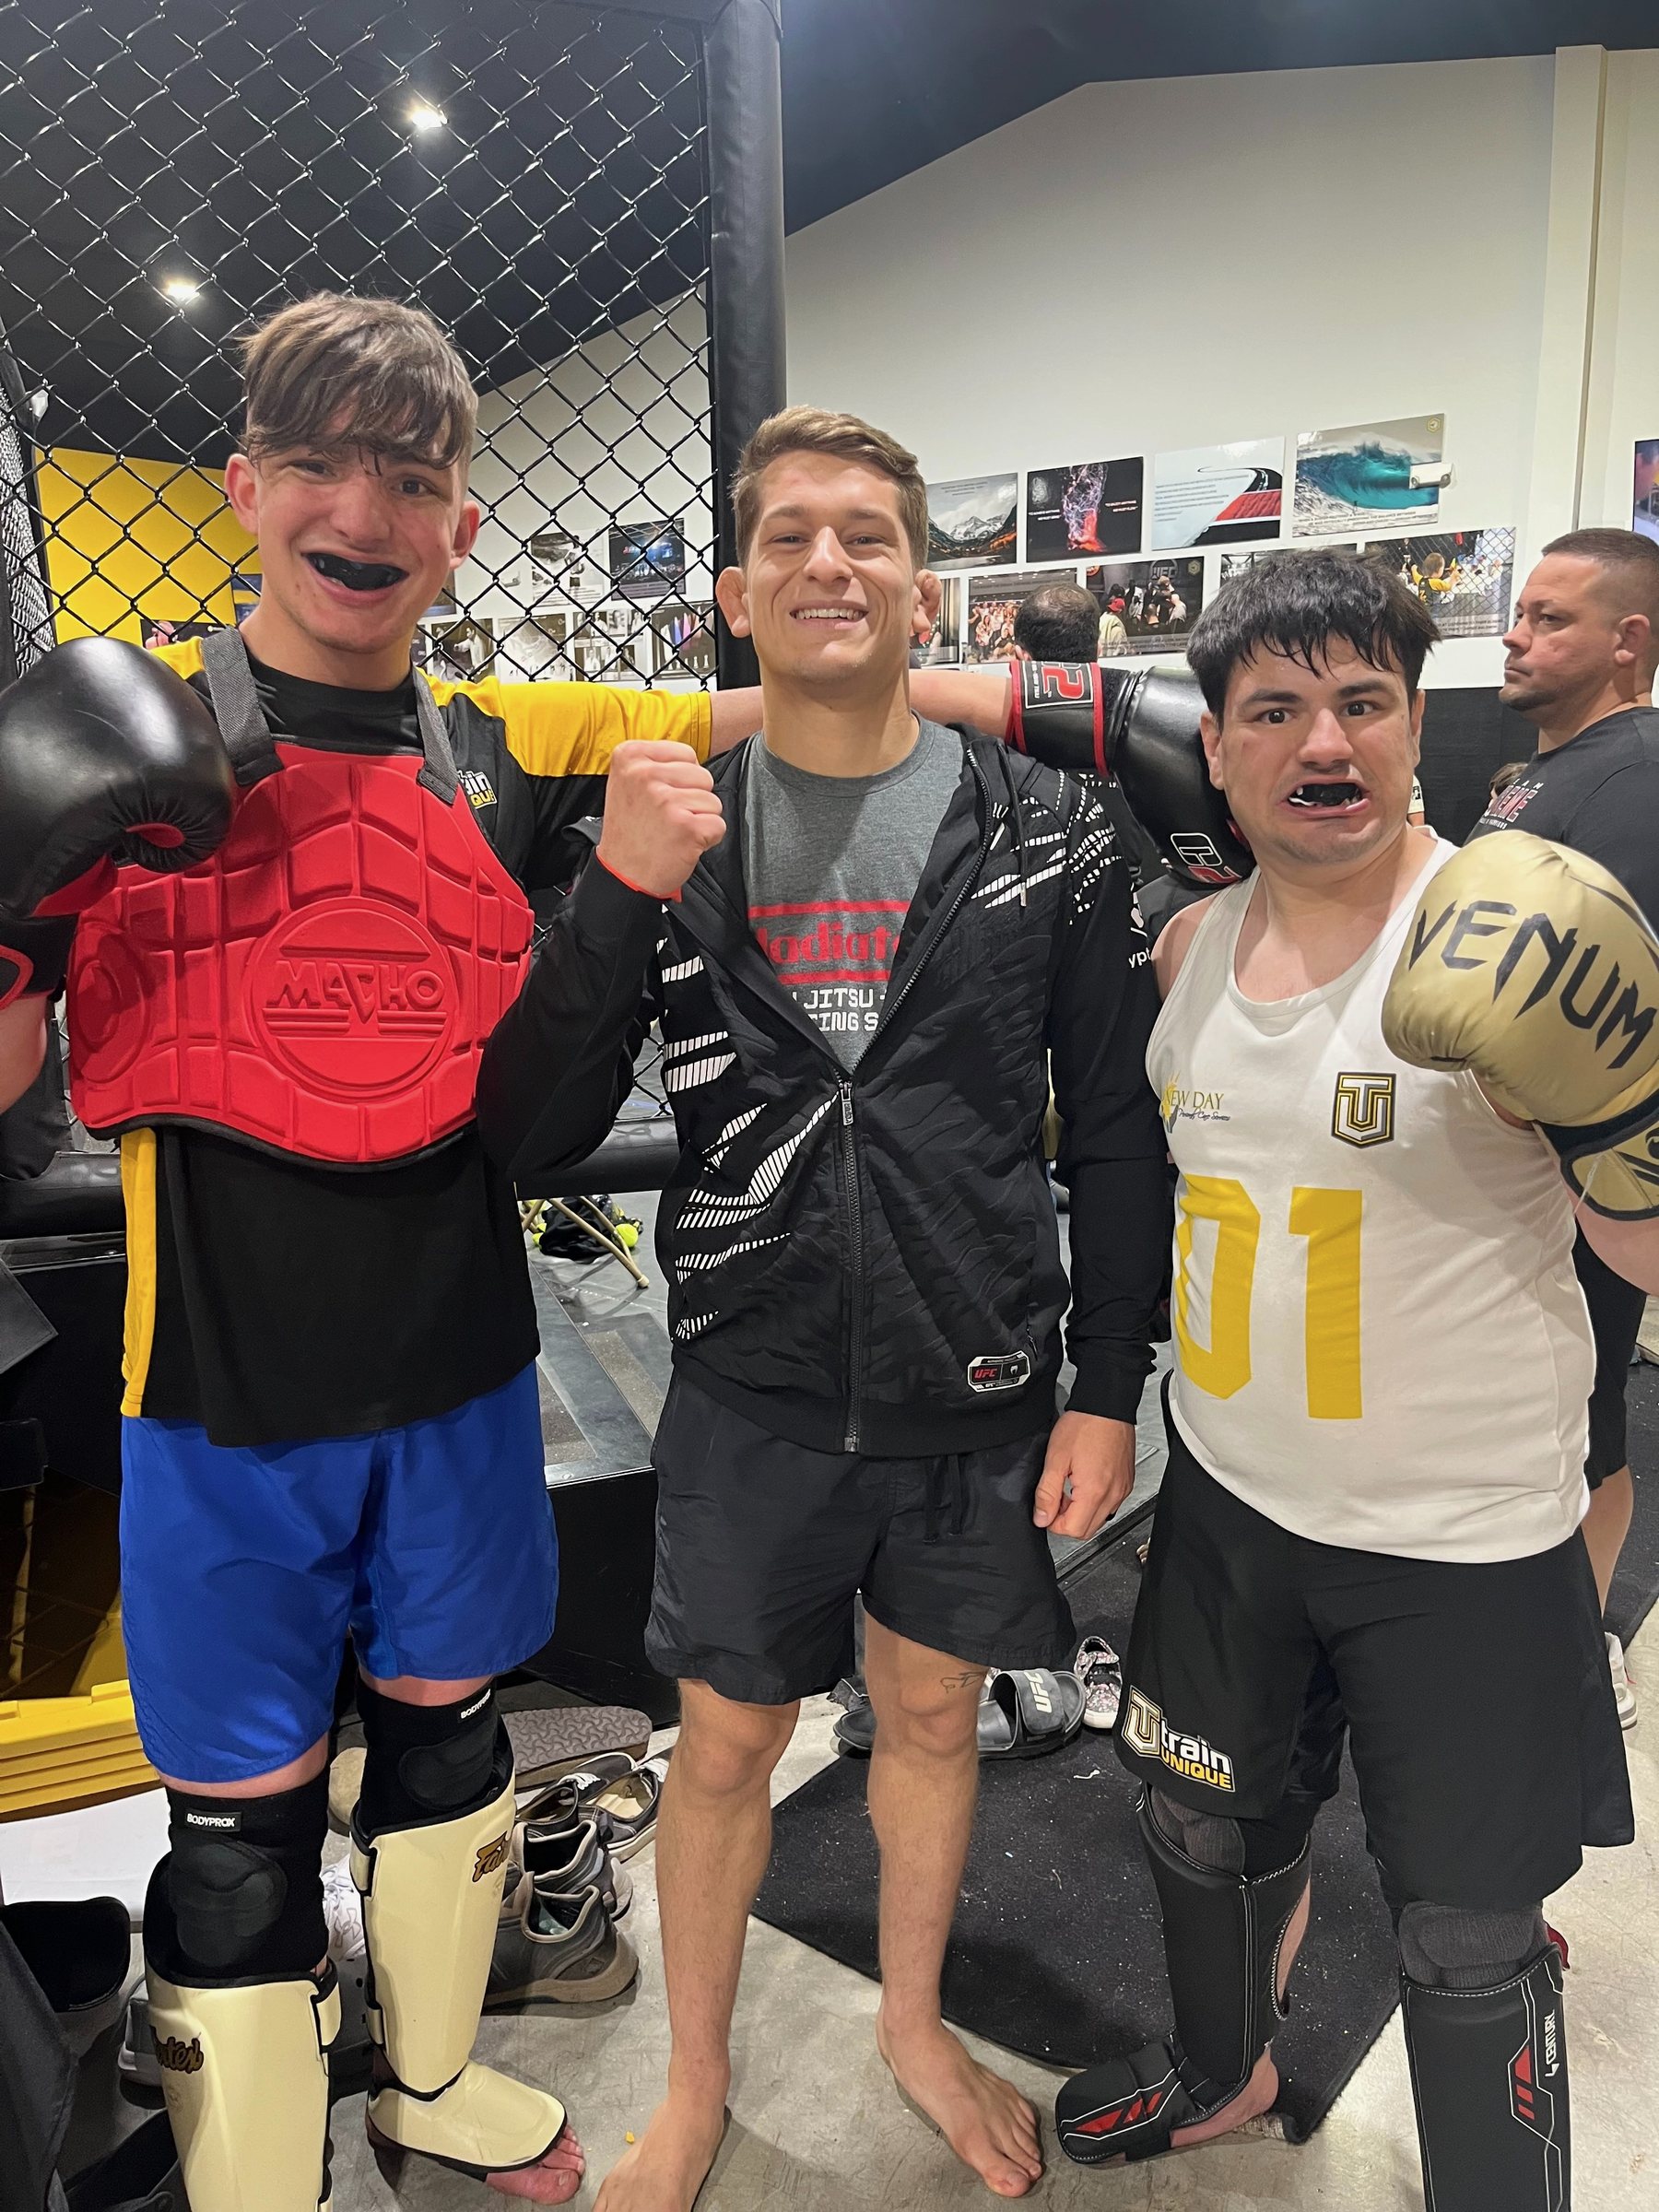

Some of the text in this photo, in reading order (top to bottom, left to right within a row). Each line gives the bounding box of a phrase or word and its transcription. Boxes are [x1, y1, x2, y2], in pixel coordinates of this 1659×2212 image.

[266, 960, 444, 1024] MACHO
[804, 987, 873, 1009] JITSU
[1408, 900, 1658, 1070] VENUM
[1193, 1091, 1224, 1111] DAY
[1175, 1173, 1363, 1419] 01
[974, 1368, 998, 1379] UFC
[1023, 1671, 1053, 1713] UFC
[1161, 1720, 1230, 1774] train
[1161, 1744, 1231, 1789] UNIQUE
[187, 1813, 235, 1827] BODYPROX
[1545, 2009, 1557, 2065] CENTURY
